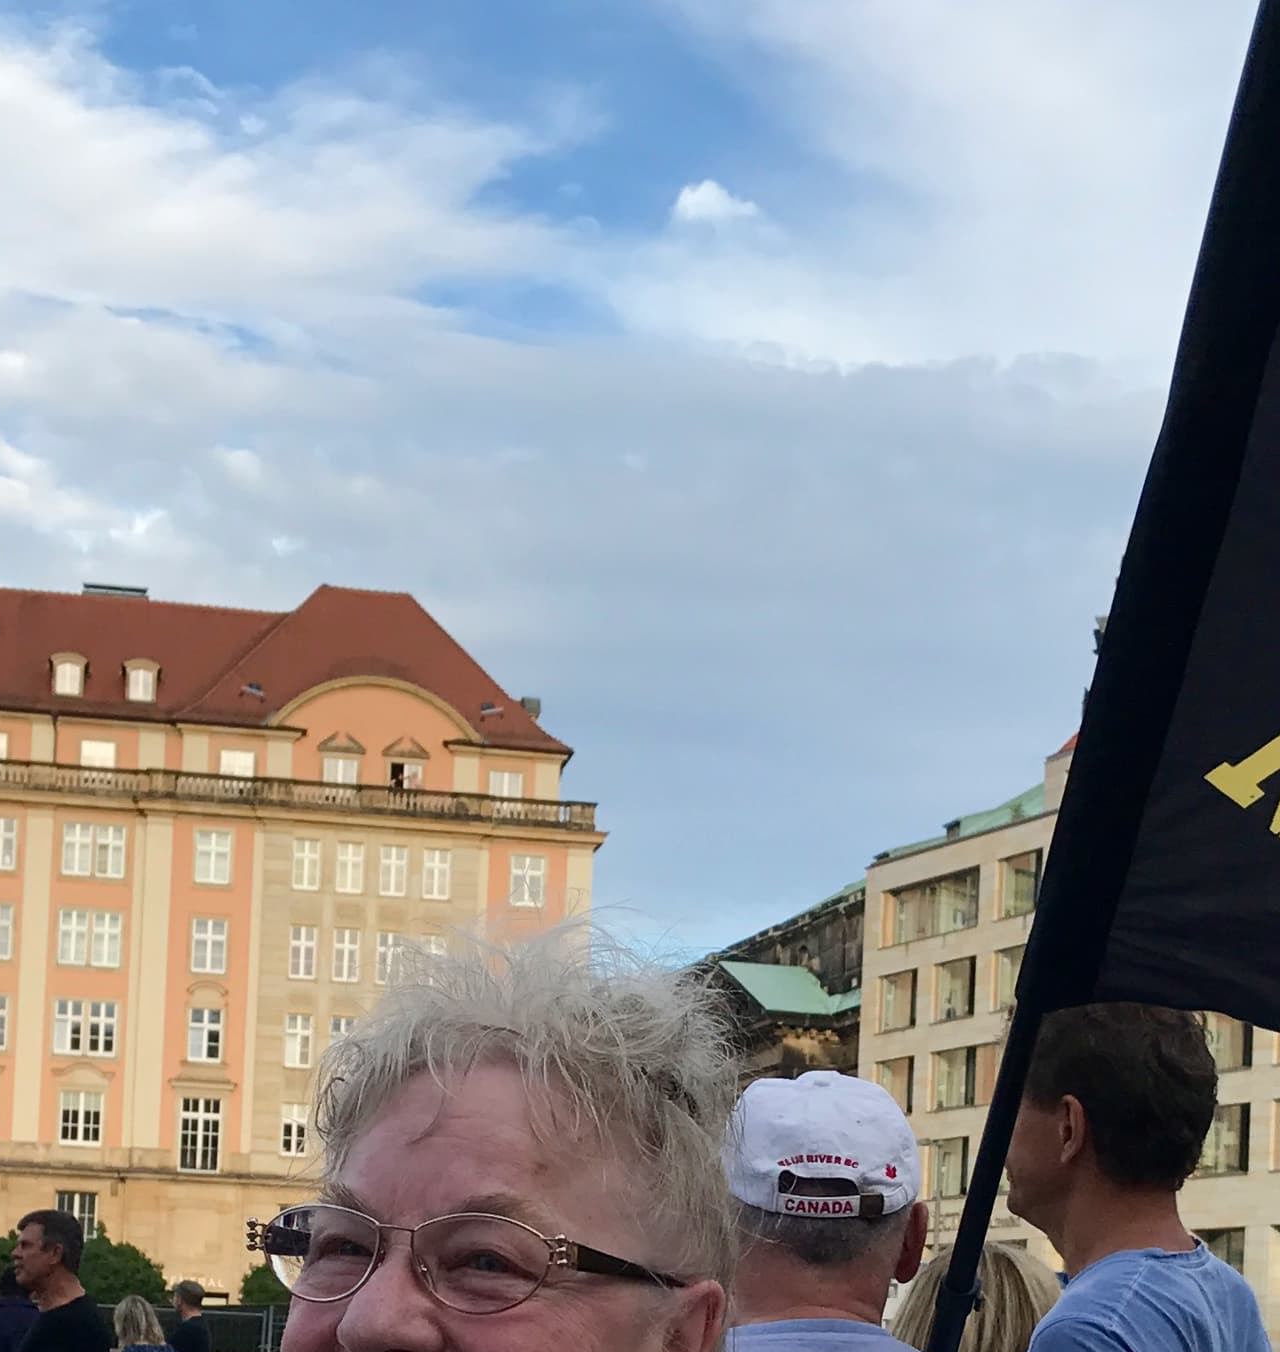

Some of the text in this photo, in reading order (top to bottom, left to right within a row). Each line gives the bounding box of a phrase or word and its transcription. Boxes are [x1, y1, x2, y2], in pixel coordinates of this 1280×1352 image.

[806, 1154, 842, 1165] RIVER
[844, 1157, 859, 1169] BC
[784, 1198, 853, 1214] CANADA
